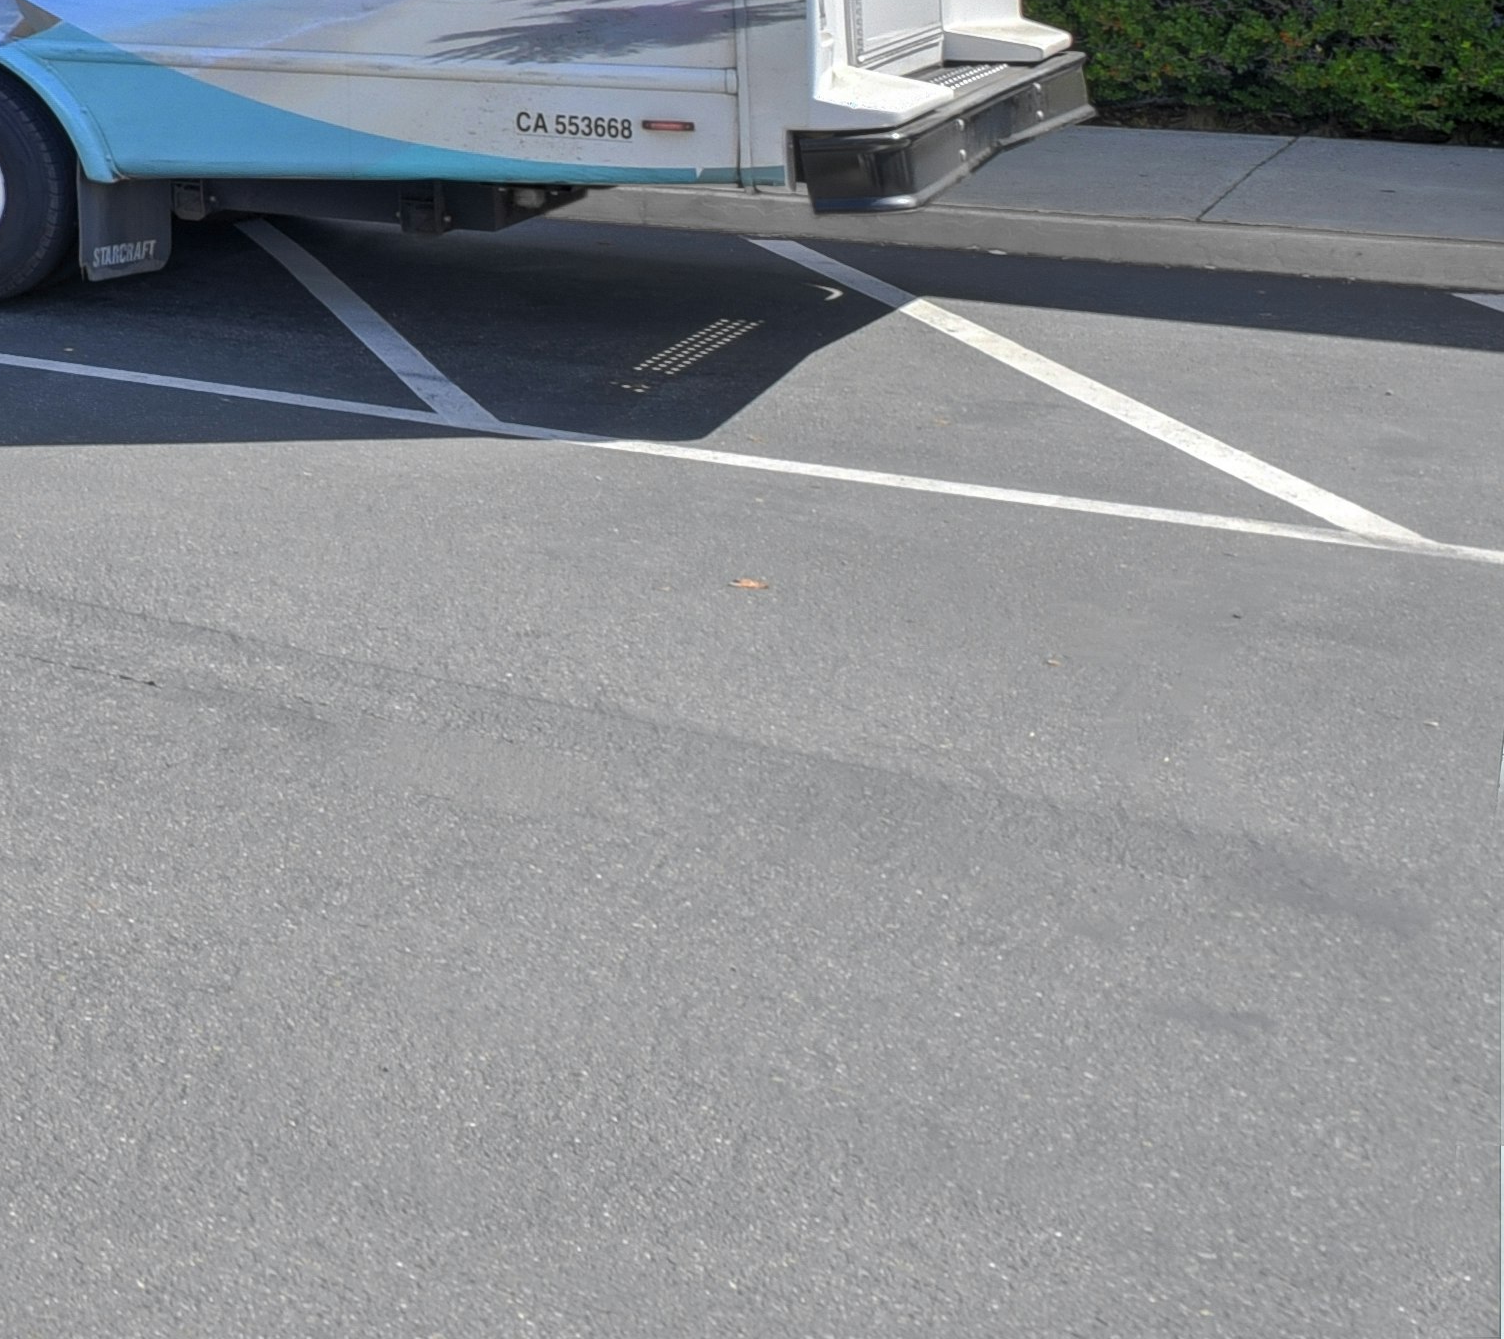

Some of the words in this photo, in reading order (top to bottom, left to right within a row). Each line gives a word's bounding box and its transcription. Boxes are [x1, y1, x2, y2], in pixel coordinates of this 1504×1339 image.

[516, 112, 549, 133] CA
[554, 114, 633, 139] 553668
[92, 239, 157, 268] STARCRAFT
